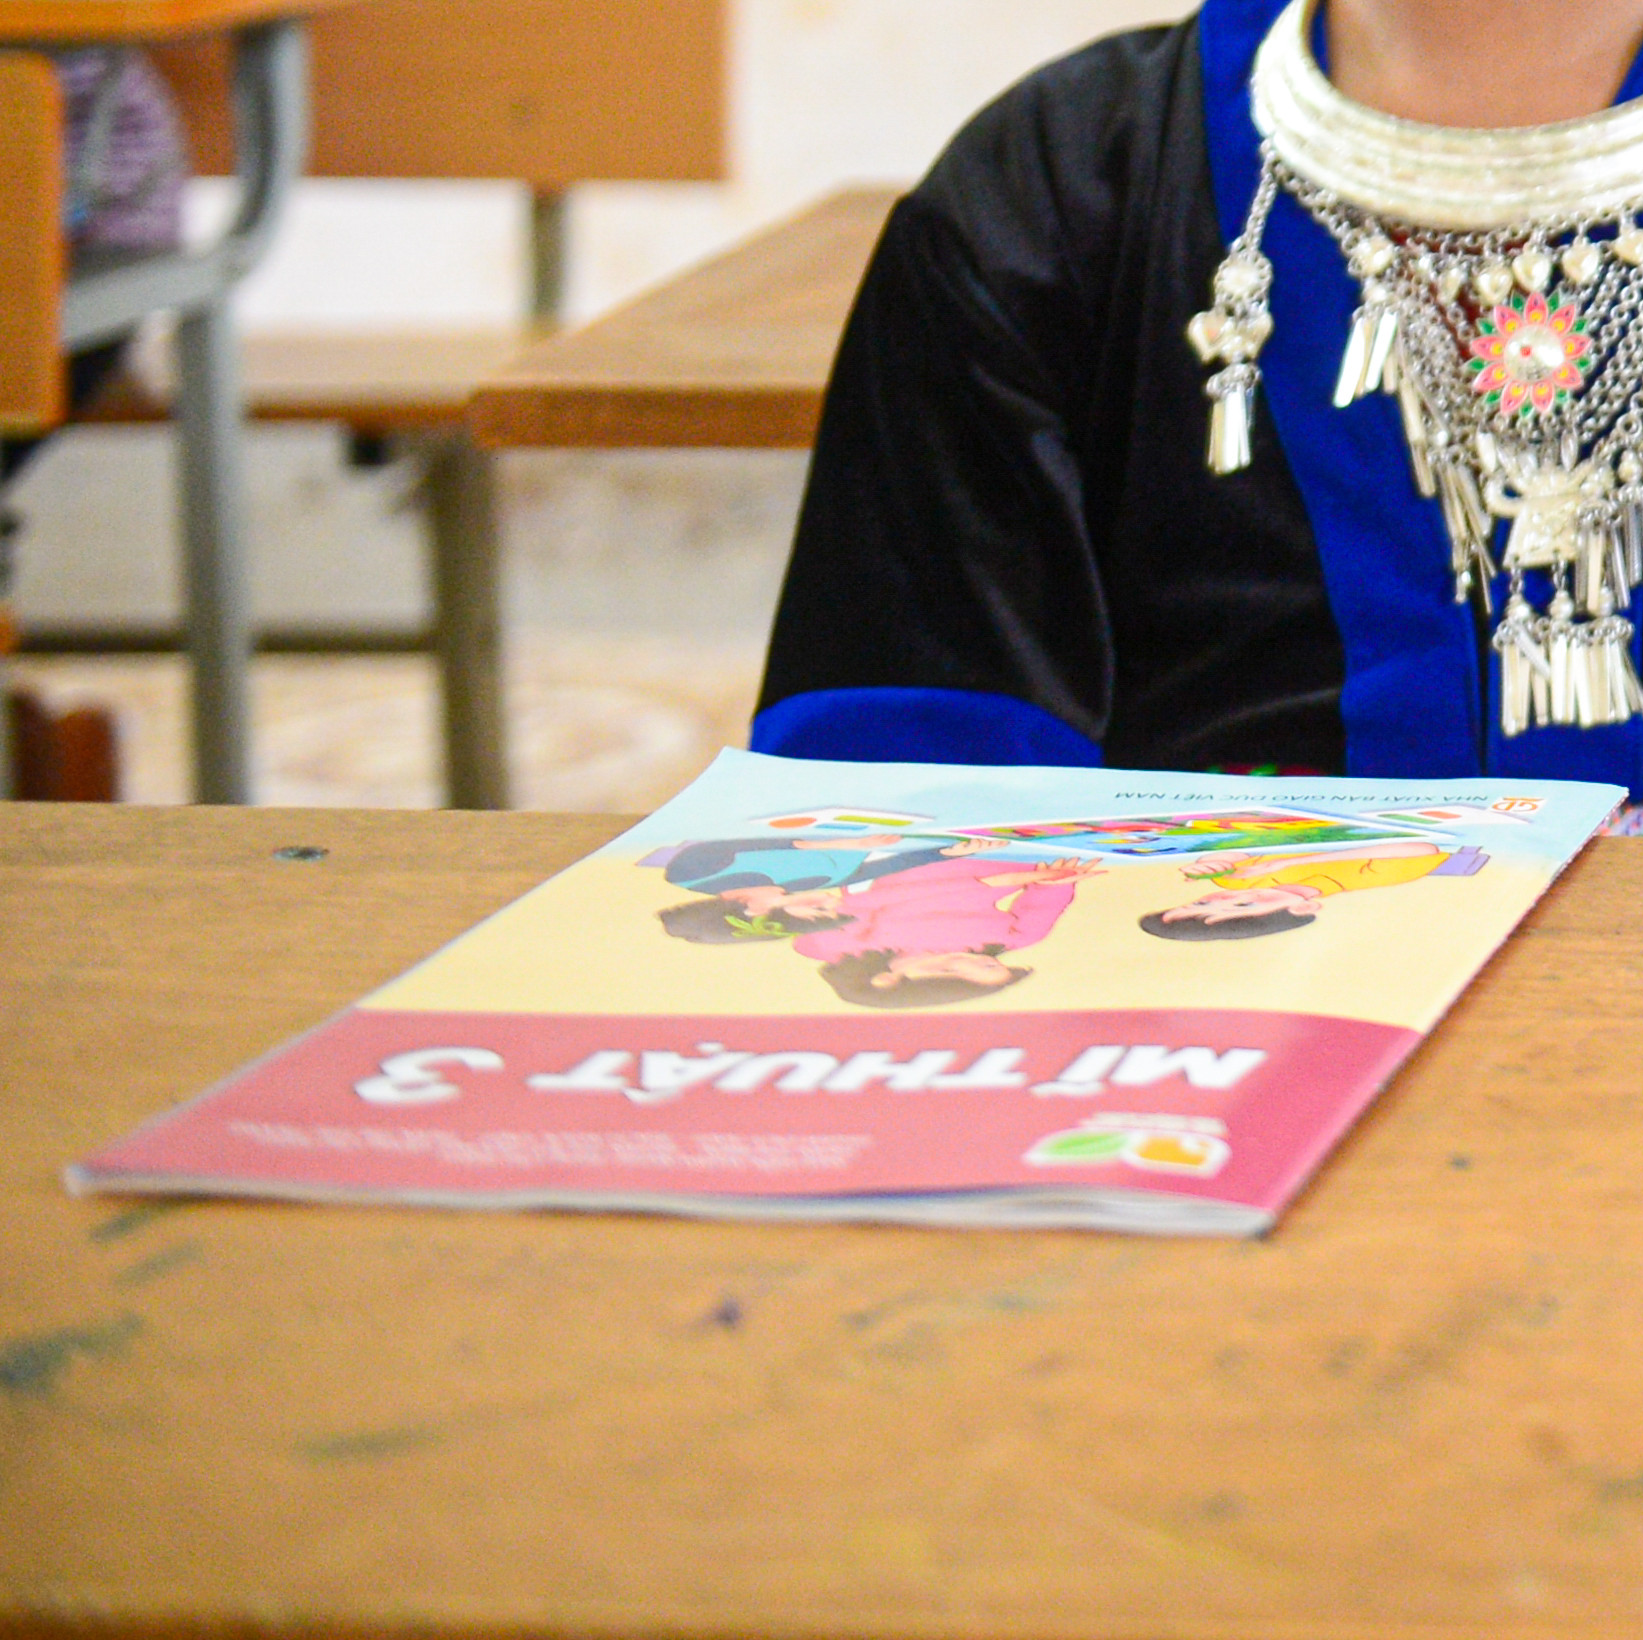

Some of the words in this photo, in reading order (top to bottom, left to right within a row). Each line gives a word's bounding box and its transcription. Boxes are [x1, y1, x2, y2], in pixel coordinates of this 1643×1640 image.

[354, 1044, 506, 1105] 3
[526, 1042, 1028, 1103] THUẬT
[1029, 1043, 1269, 1097] MĨ
